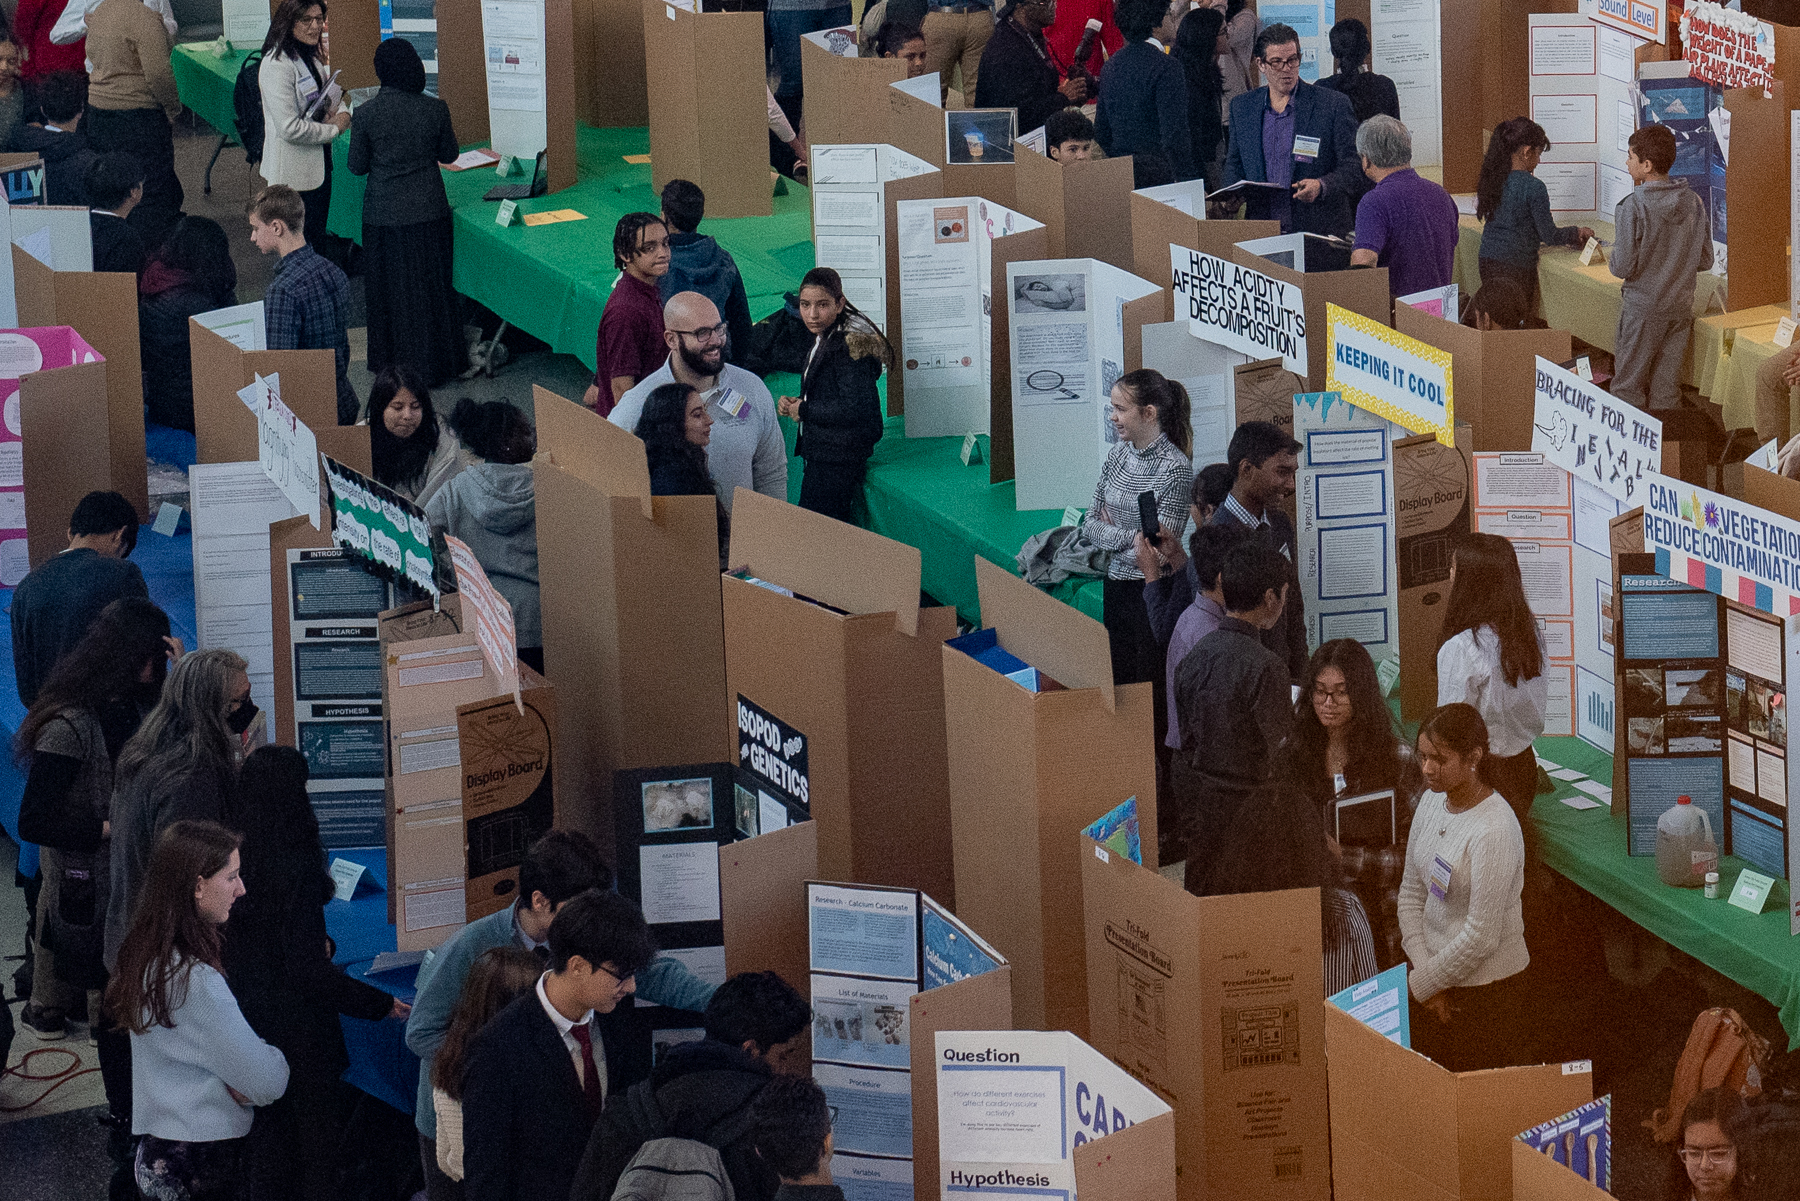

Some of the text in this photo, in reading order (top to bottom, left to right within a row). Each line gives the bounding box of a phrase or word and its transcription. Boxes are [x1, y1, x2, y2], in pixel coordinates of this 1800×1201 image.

[1632, 4, 1656, 29] Level
[1690, 32, 1723, 56] WEIGHT
[1712, 24, 1757, 51] DOES THE
[1189, 251, 1285, 306] HOW ACIDTY
[1173, 269, 1305, 338] AFFECTS A FRUIT'S
[1190, 297, 1297, 359] DECOMPOSITION
[1336, 342, 1445, 407] KEEPING IT COOL
[1536, 369, 1659, 450] BRACING FOR THE
[1399, 489, 1463, 512] Display Board
[1649, 483, 1679, 518] CAN
[1511, 513, 1537, 521] Question
[1645, 513, 1700, 557] REDUCE
[1624, 577, 1680, 587] Research
[322, 627, 360, 637] RESEARCH
[325, 706, 369, 716] HYPOTHESIS
[737, 701, 782, 751] ISOPOD
[466, 757, 544, 790] Display Board
[750, 743, 809, 803] GENETICS
[662, 850, 695, 860] MATERIALS
[815, 895, 908, 912] Research Calcium Carbonate
[1126, 919, 1150, 941] Tri-Fold
[1149, 949, 1172, 971] Board
[1245, 968, 1270, 977] Tri-Fold
[1270, 973, 1294, 983] Board
[839, 988, 889, 1001] List Materials
[943, 1048, 1020, 1064] Question
[849, 1078, 881, 1089] Procedure
[982, 1090, 1046, 1098] different exercises
[985, 1100, 1037, 1108] cardiovascular
[852, 1168, 881, 1178] Variables
[950, 1170, 1050, 1188] Hypothesis
